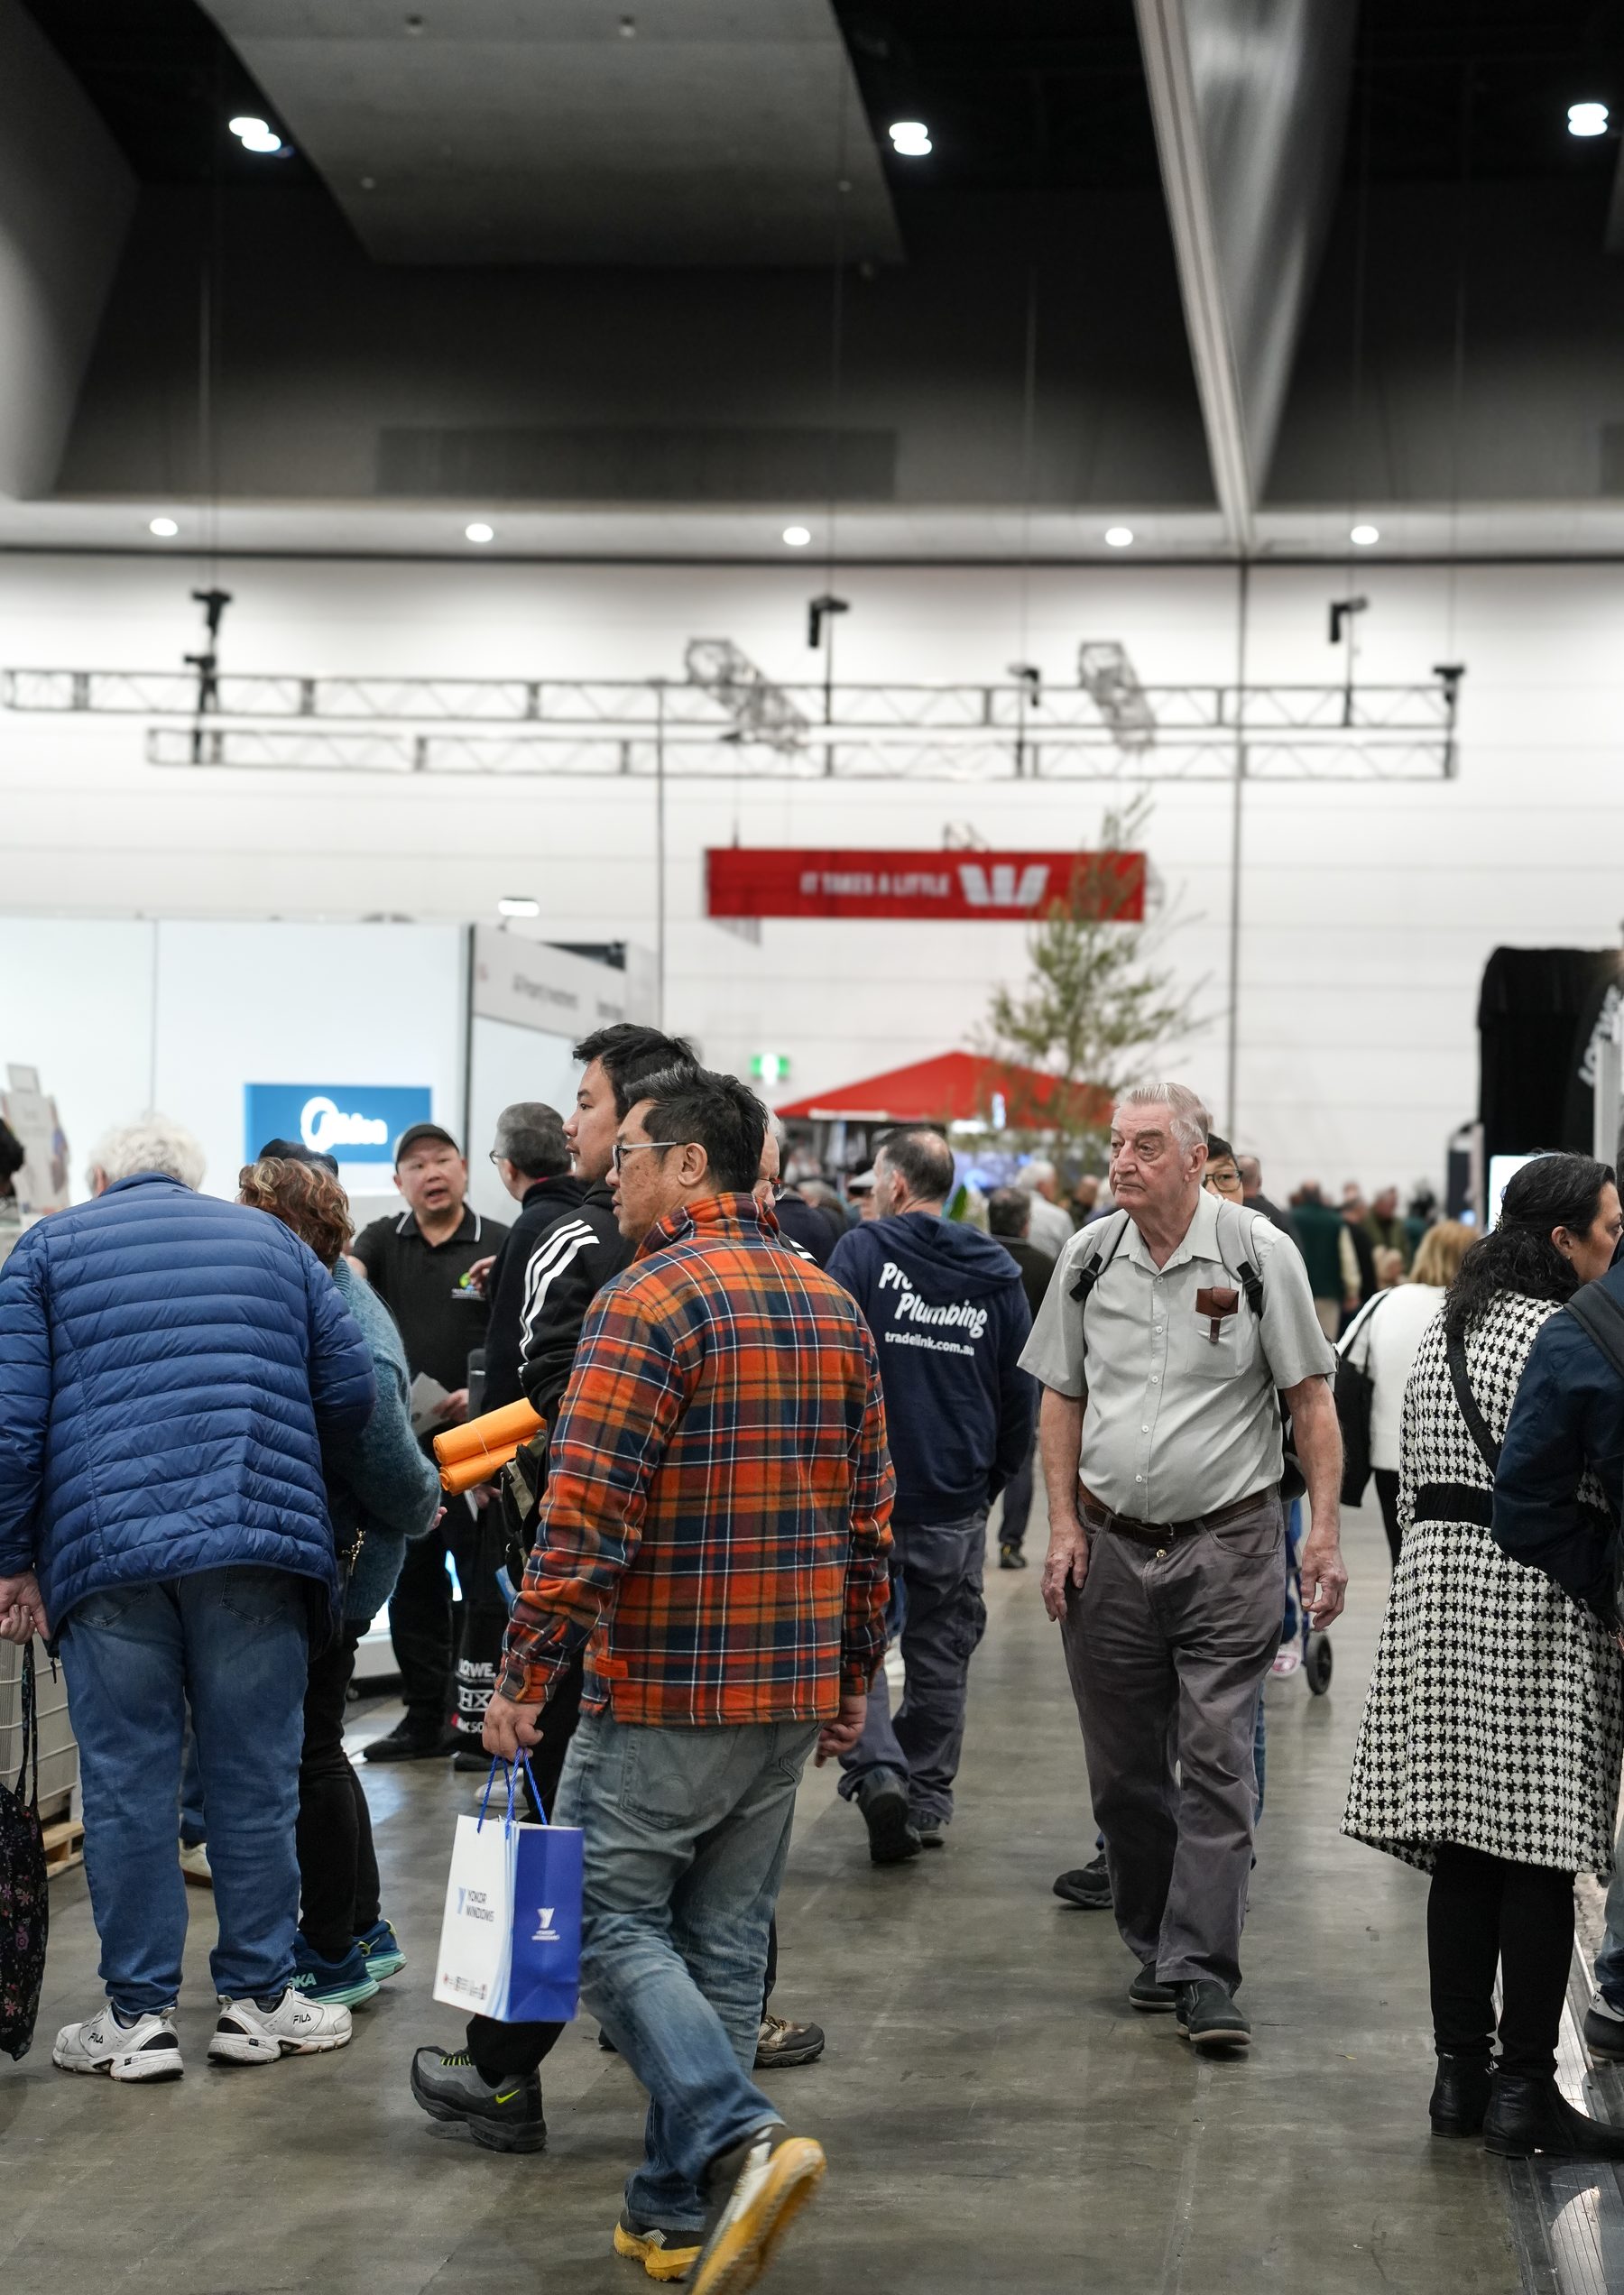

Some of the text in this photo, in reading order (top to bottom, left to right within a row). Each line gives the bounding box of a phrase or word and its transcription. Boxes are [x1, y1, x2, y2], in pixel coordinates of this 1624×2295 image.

[822, 871, 873, 896] TAKES
[894, 1292, 988, 1340] Plumbing
[884, 1331, 974, 1357] tradelink.com.au
[289, 1972, 318, 1988] KA
[293, 2013, 311, 2025] FILA
[88, 2032, 104, 2044] FILA
